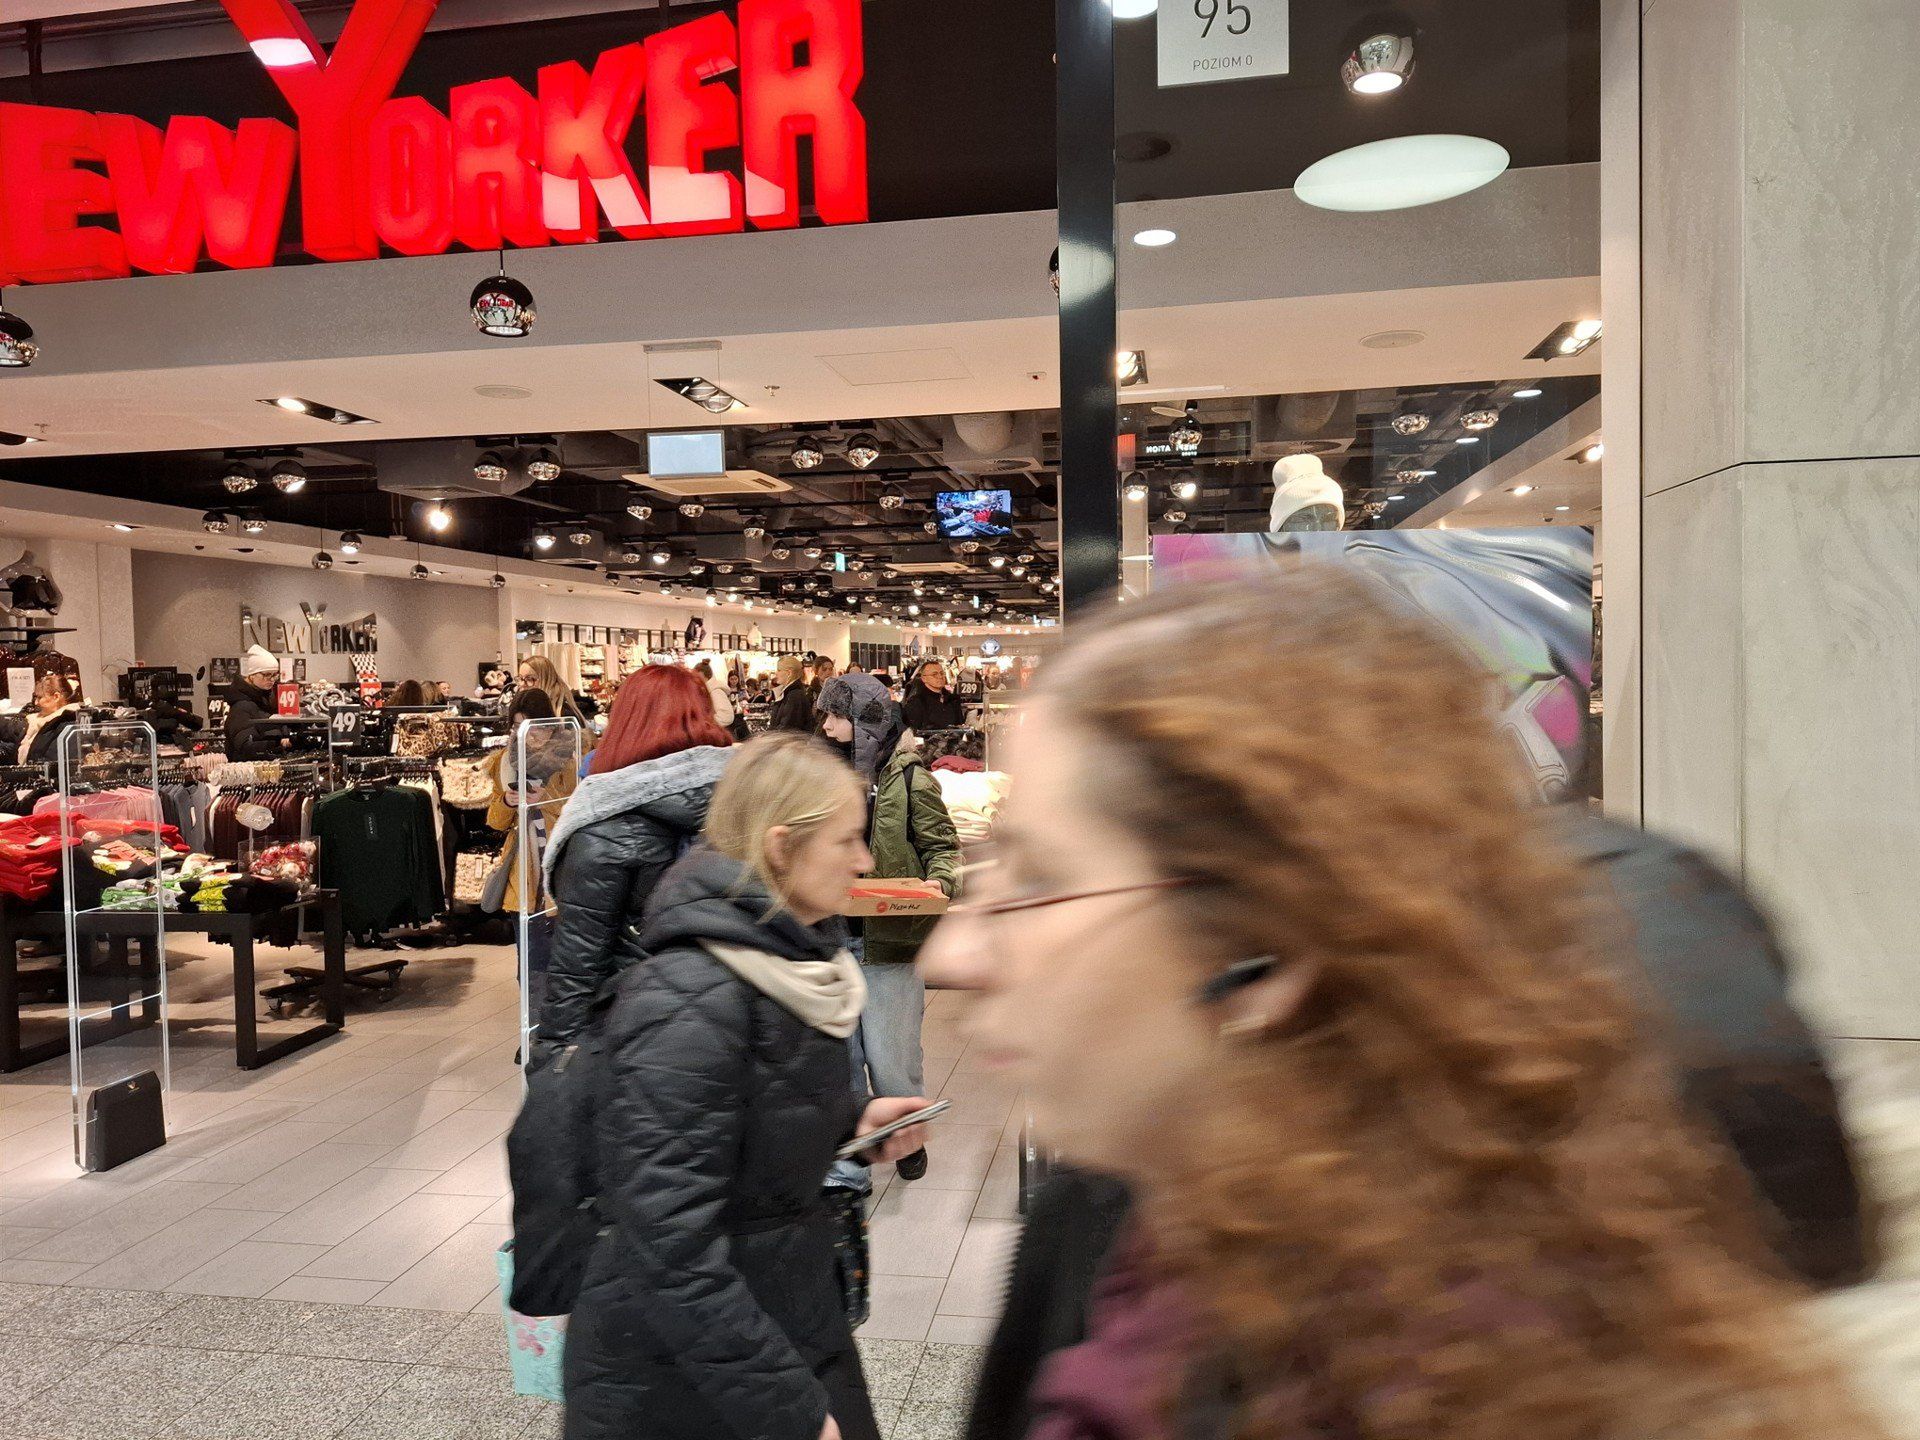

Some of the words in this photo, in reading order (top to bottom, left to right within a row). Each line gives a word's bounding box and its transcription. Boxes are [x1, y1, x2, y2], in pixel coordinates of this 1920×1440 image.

[1194, 0, 1251, 38] 95
[1193, 56, 1241, 71] POZIOM
[961, 682, 978, 694] 289
[208, 699, 222, 713] 49
[279, 691, 295, 707] 49
[332, 711, 356, 732] 49
